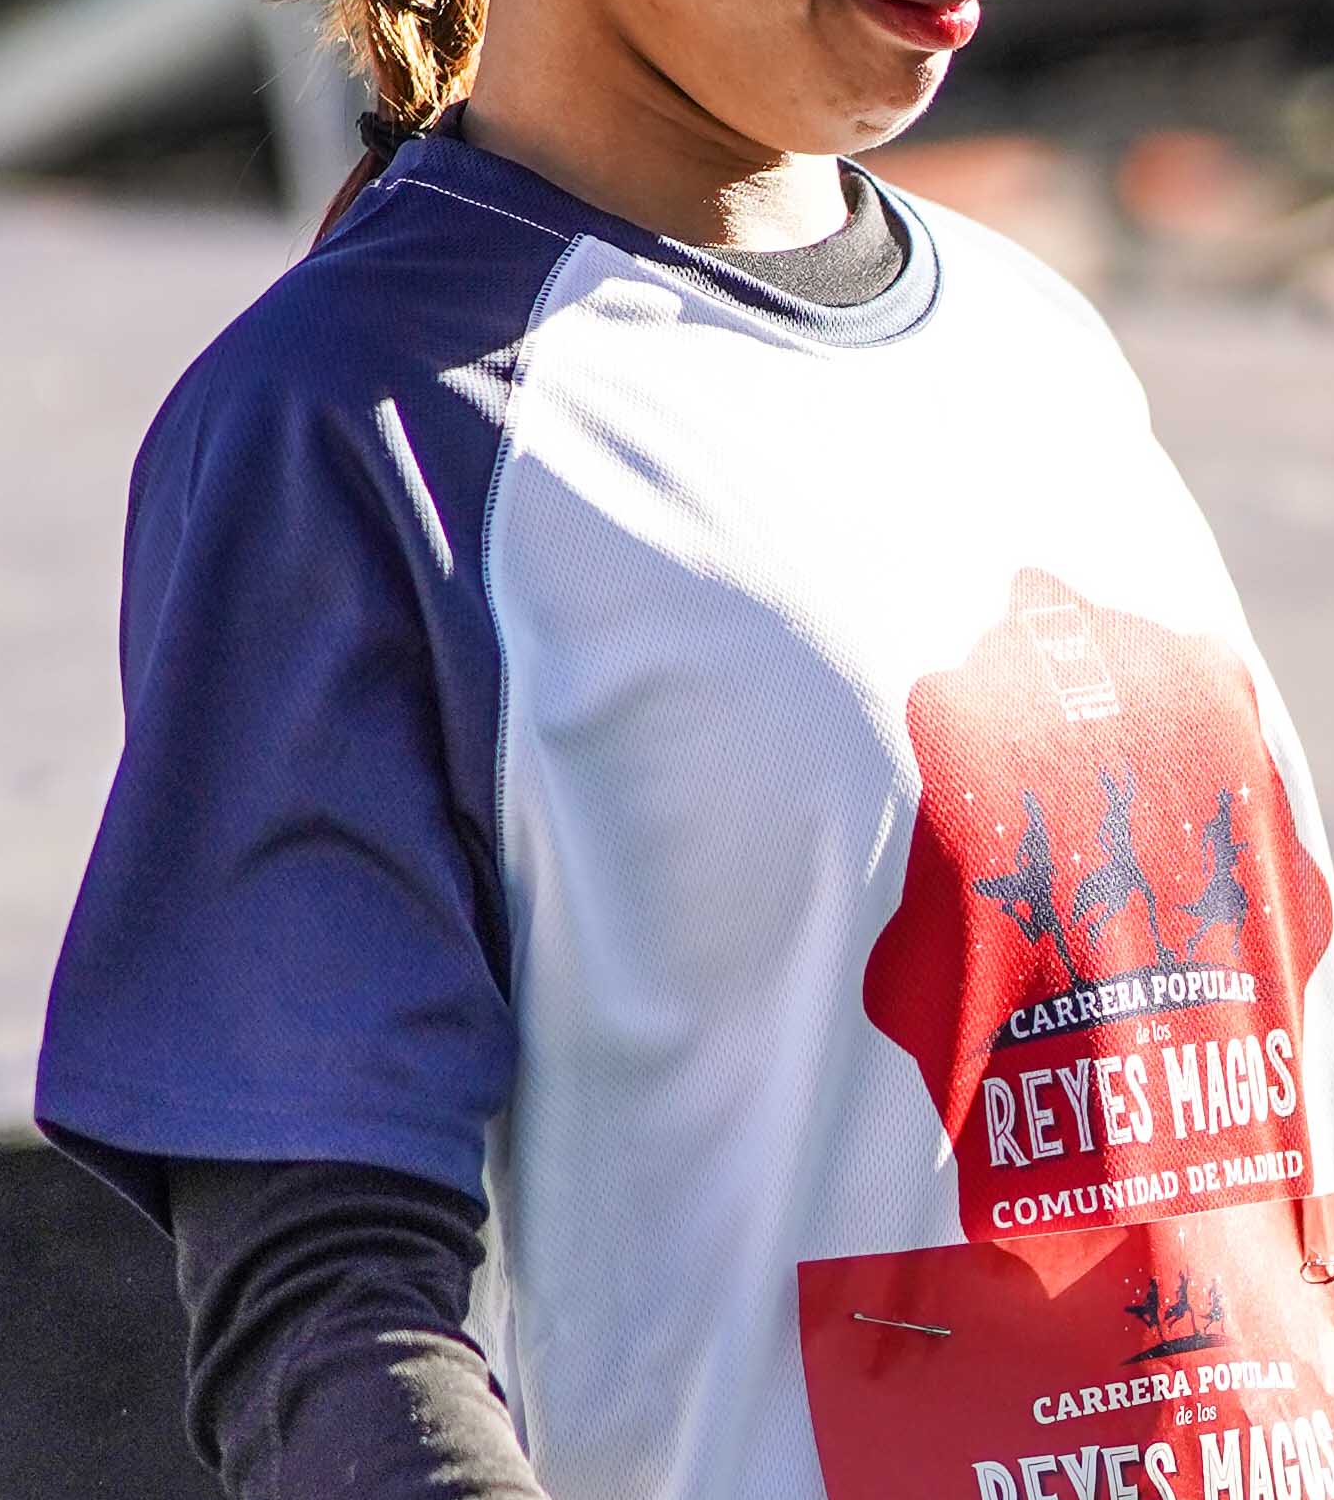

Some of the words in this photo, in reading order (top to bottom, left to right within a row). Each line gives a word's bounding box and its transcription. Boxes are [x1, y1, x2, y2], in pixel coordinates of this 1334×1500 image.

[1010, 984, 1151, 1039] CARRERA
[1151, 971, 1256, 1003] POPULAR
[1136, 1020, 1150, 1044] de
[1151, 1020, 1172, 1042] los
[983, 1053, 1154, 1168] REYES
[1162, 1029, 1297, 1139] MAGOS
[992, 1172, 1179, 1229] COMUNIDAD
[1187, 1164, 1219, 1194] DE
[1224, 1150, 1304, 1188] MADRID
[1033, 1370, 1192, 1425] CARRERA
[1197, 1361, 1296, 1394] POPULAR
[1175, 1406, 1193, 1426] de
[1196, 1402, 1217, 1423] los
